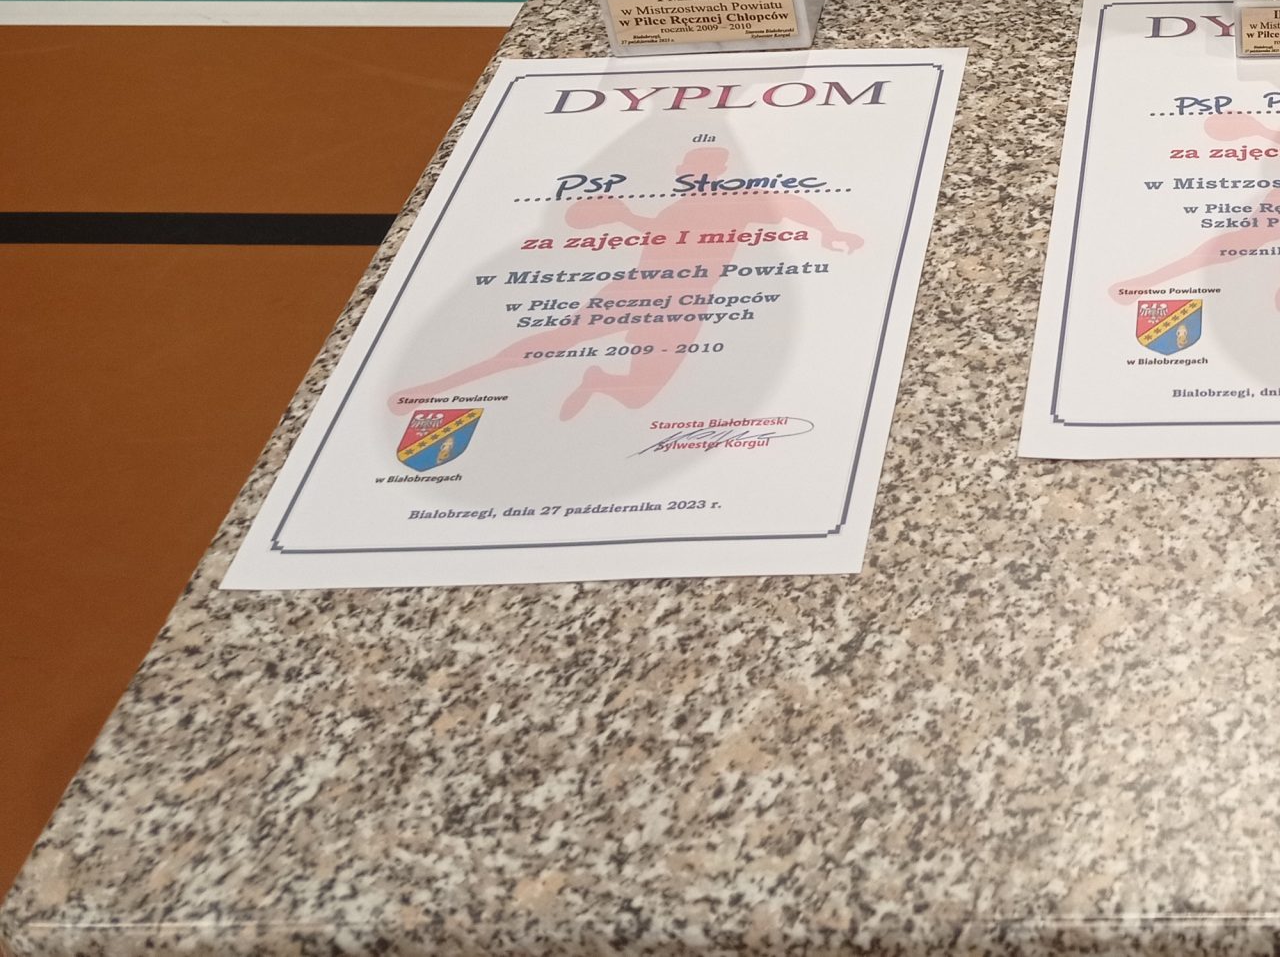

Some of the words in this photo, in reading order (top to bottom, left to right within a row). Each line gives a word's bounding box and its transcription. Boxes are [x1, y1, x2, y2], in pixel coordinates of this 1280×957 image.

[636, 3, 727, 15] Mistrzostwach
[732, 2, 782, 10] Powiatu
[670, 14, 722, 26] Ręcznej
[546, 81, 891, 114] DYPLOM
[1174, 96, 1232, 115] PSP
[693, 134, 716, 142] dla
[1170, 150, 1199, 158] za
[556, 174, 627, 201] PSP
[673, 173, 827, 193] Stromiec
[1205, 204, 1252, 213] Piłce
[1201, 218, 1258, 228] Szkół
[521, 239, 553, 249] za
[564, 232, 666, 251] zajęcie
[676, 231, 690, 244] I
[698, 229, 808, 246] miejsca
[476, 276, 496, 285] w
[504, 265, 708, 284] Mistrzostwach
[720, 262, 828, 277] Powiatu
[528, 299, 580, 311] Piłce
[586, 296, 672, 310] Ręcznej
[679, 292, 780, 307] Chłopców
[517, 315, 580, 327] Szkół
[588, 309, 754, 325] Podstawowych
[524, 347, 598, 358] rocznik
[605, 345, 653, 356] 2009
[675, 343, 724, 353] 2010
[1138, 357, 1208, 366] Białobrzegach
[1173, 388, 1254, 398] Białobrzegi,
[650, 421, 704, 429] Starosta
[709, 417, 787, 428] Białobrzeski
[387, 474, 462, 483] Białobrzegach
[408, 508, 496, 519] Białobrzegi,
[503, 507, 535, 516] dnia
[540, 506, 561, 515] 27
[564, 502, 661, 517] października
[667, 500, 706, 510] 2023
